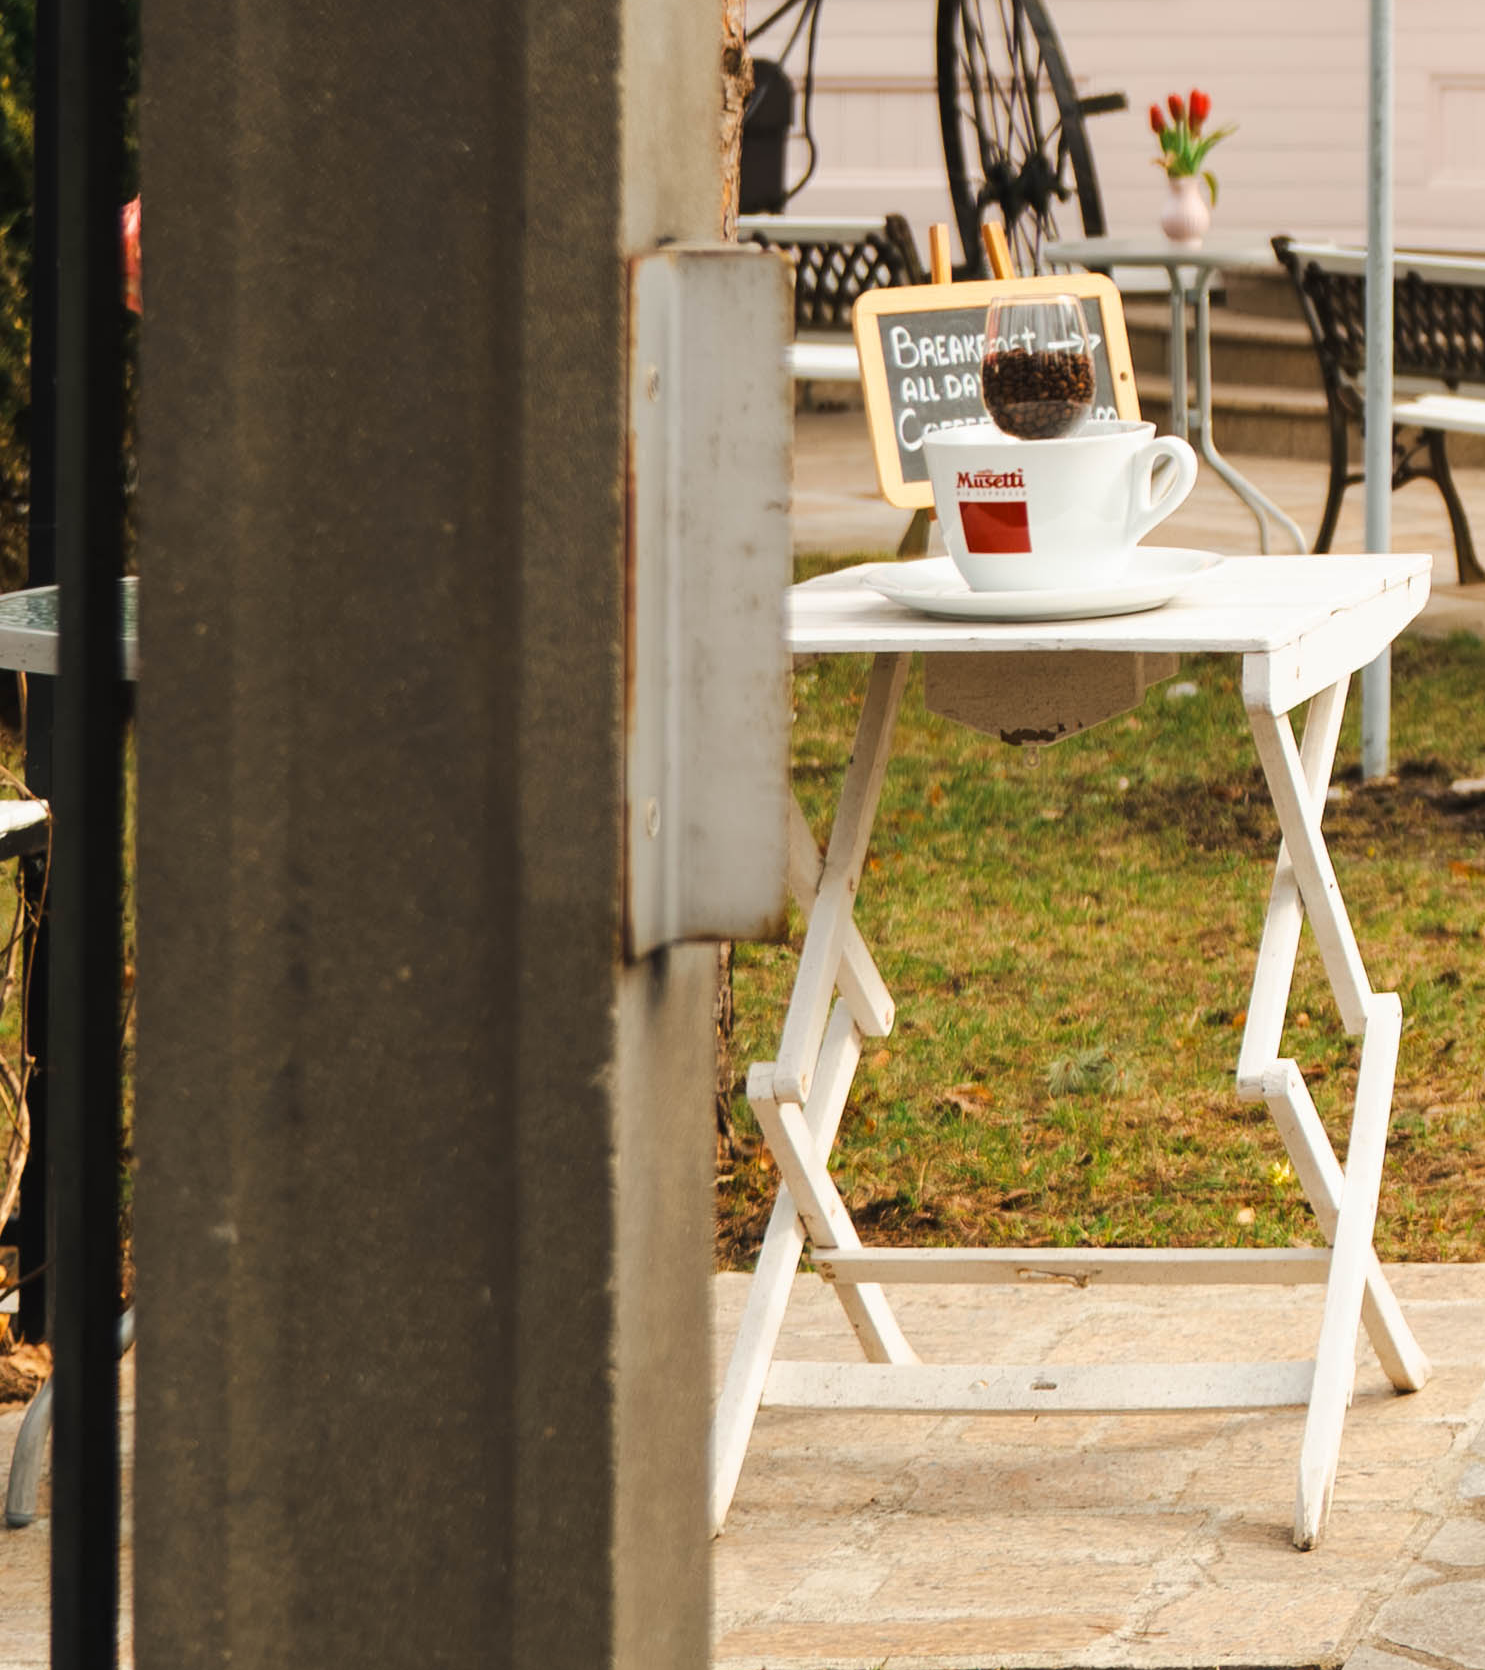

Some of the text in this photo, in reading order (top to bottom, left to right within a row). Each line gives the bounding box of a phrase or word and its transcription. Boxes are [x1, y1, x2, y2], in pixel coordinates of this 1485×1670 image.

[902, 372, 981, 403] ALL DA
[957, 467, 1025, 488] Musetti
